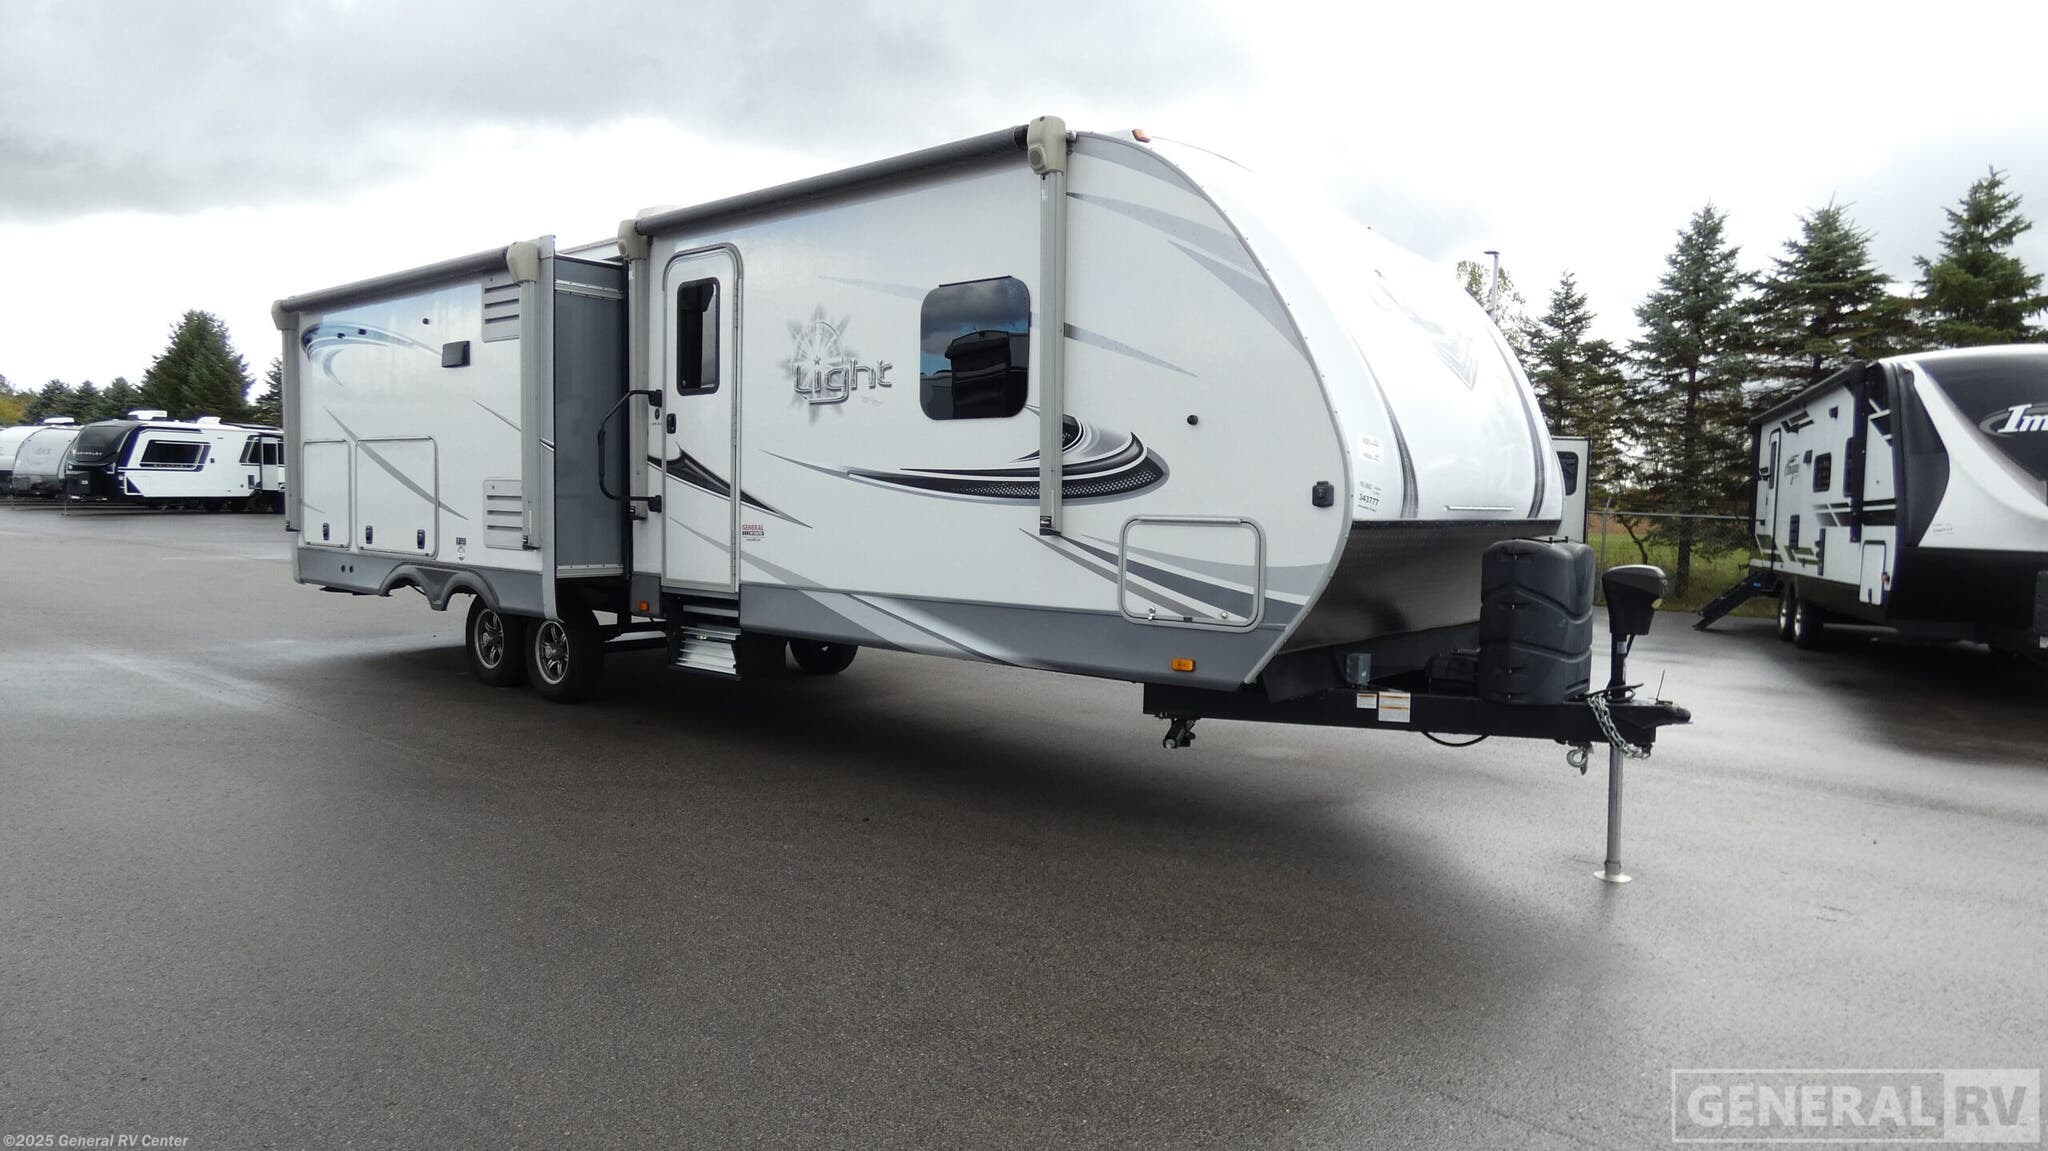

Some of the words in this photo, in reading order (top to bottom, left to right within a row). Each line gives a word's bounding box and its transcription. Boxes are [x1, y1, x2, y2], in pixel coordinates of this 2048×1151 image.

[793, 356, 893, 405] Light
[1997, 404, 2048, 432] Im
[1359, 493, 1380, 506] 343777
